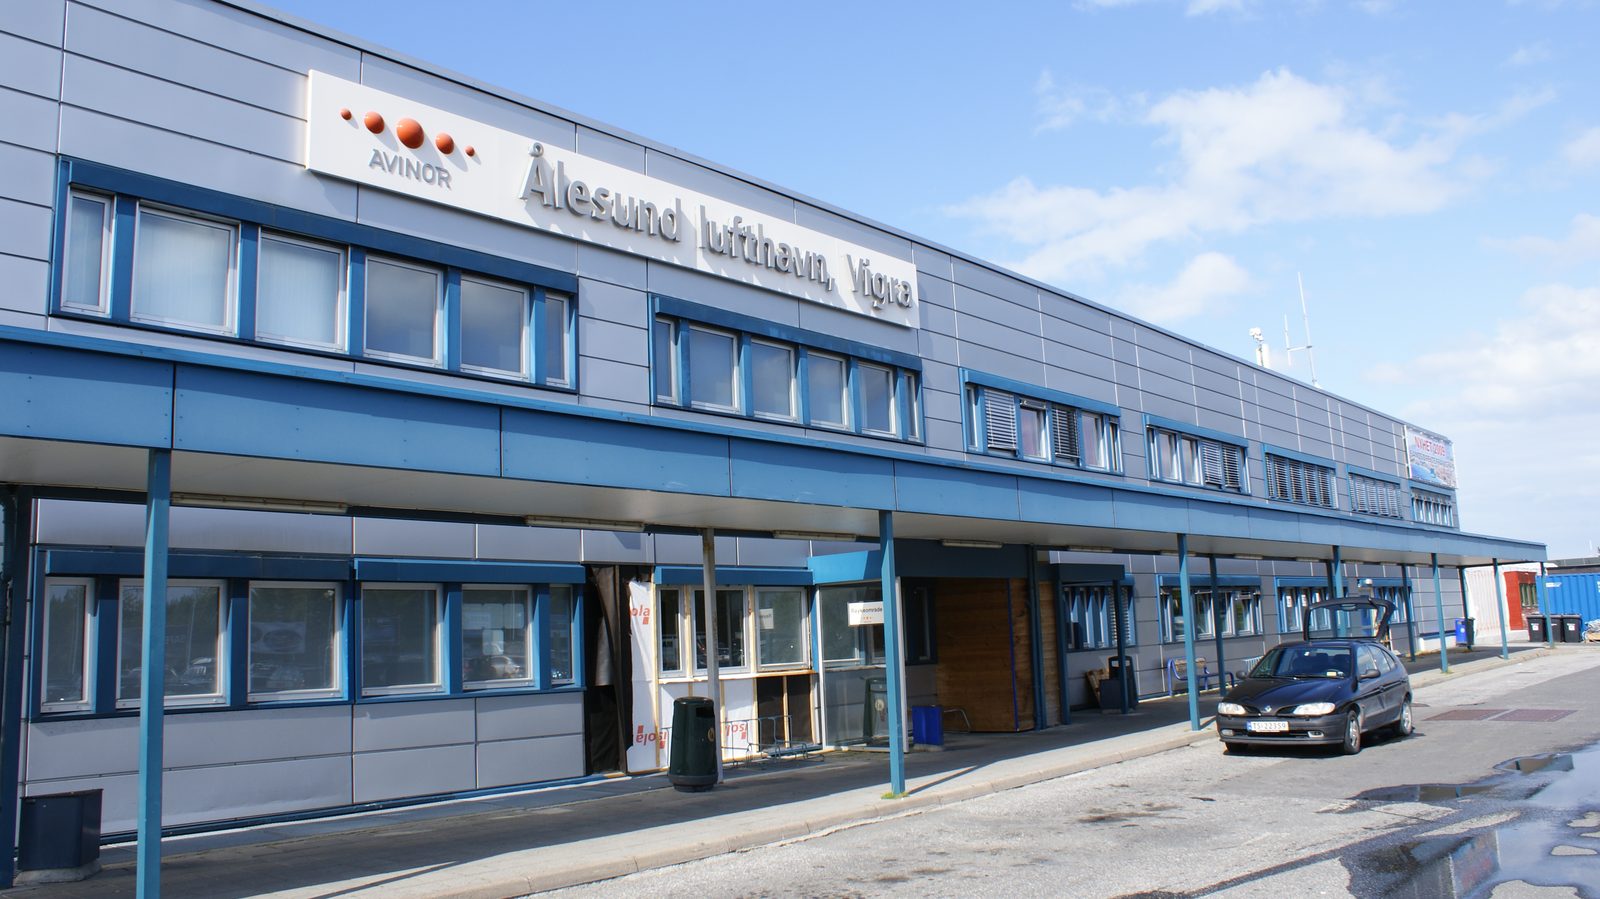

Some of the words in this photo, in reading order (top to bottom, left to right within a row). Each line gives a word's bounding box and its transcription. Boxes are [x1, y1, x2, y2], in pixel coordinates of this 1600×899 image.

[369, 148, 453, 190] AVINOR
[518, 142, 681, 243] Ålesund
[695, 204, 836, 292] lufthavn,
[846, 253, 912, 310] Vigra
